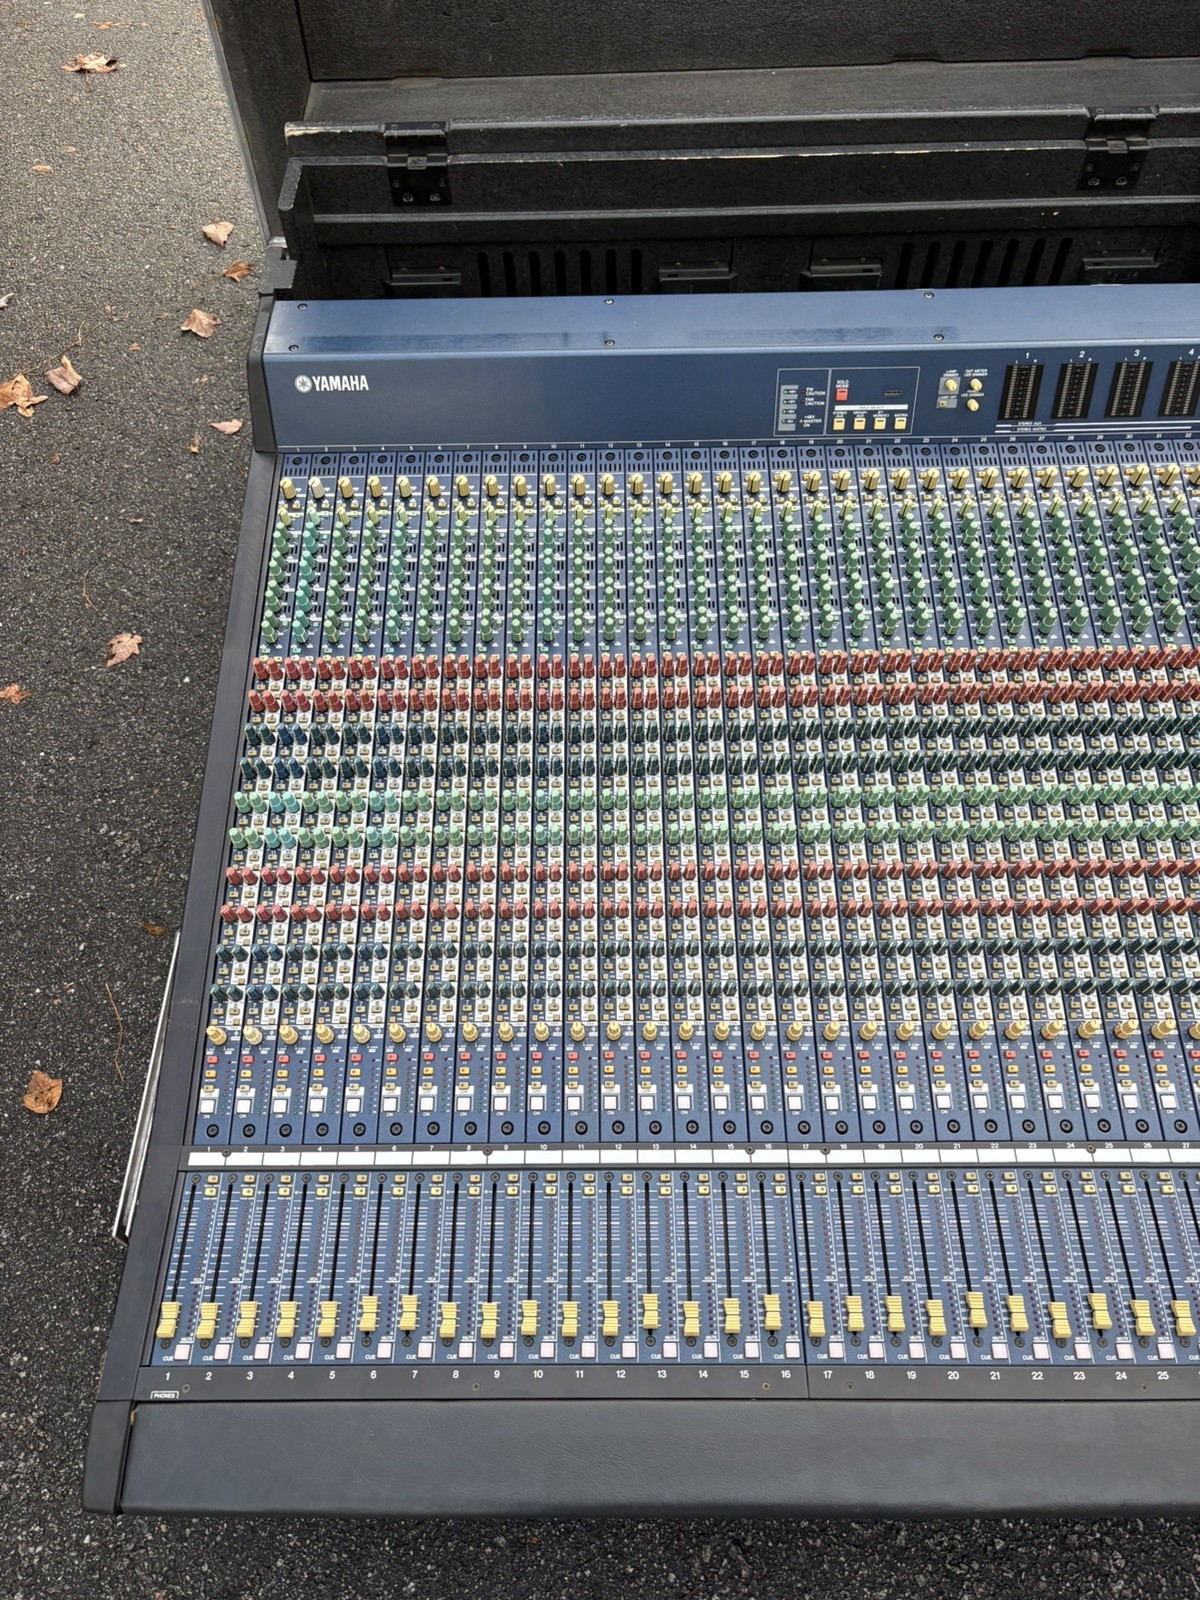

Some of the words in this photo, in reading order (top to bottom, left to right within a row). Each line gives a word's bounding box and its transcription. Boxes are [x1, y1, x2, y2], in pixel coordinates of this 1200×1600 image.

[1134, 349, 1140, 357] 3
[312, 375, 369, 391] YAMAHA
[165, 1372, 171, 1380] 1
[205, 1372, 212, 1380] 2
[247, 1371, 253, 1380] 3
[288, 1371, 294, 1379] 4
[329, 1371, 335, 1379] 5
[371, 1371, 376, 1379] 6
[412, 1370, 418, 1378] 7
[453, 1370, 459, 1378] 8
[494, 1370, 500, 1378] 9
[533, 1370, 543, 1378] 10
[576, 1370, 583, 1378] 11
[616, 1370, 625, 1378] 12
[657, 1370, 667, 1378] 13
[699, 1370, 708, 1378] 14
[740, 1370, 749, 1378] 15
[781, 1370, 791, 1378] 16
[823, 1370, 832, 1379] 17
[865, 1371, 874, 1379] 18
[907, 1371, 916, 1379] 19
[948, 1371, 959, 1380] 20
[990, 1371, 1000, 1380] 21
[1032, 1372, 1043, 1380] 22
[1074, 1372, 1085, 1380] 23
[1115, 1372, 1127, 1380] 24
[1157, 1371, 1169, 1380] 25
